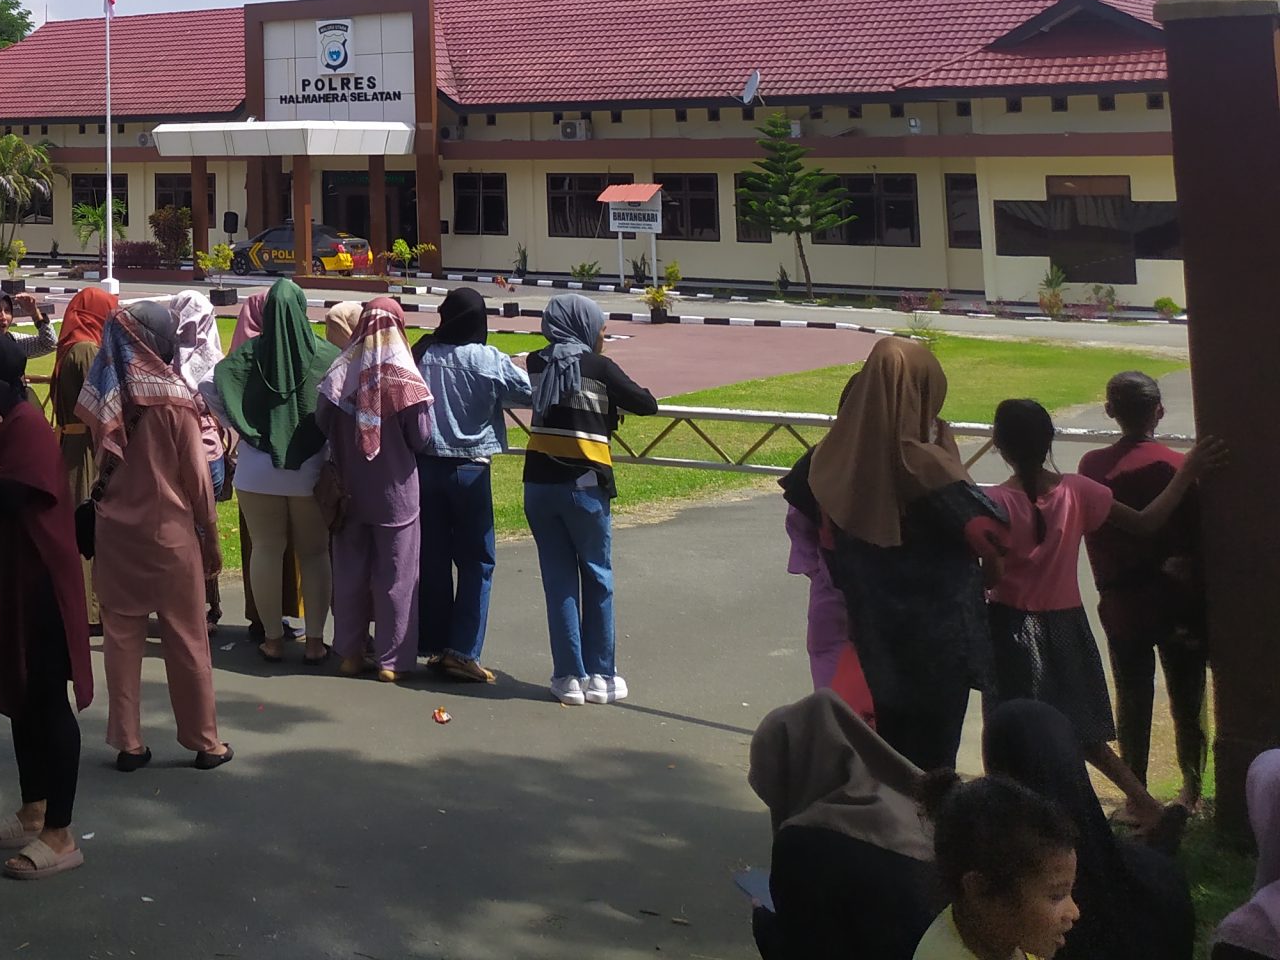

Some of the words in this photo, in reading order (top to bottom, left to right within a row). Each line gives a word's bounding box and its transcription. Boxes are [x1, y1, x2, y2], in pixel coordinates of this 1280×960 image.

[301, 76, 377, 91] POLRES
[279, 93, 348, 105] HALMAHERA
[349, 91, 402, 102] SELATAN
[612, 212, 658, 223] BHAYANGKARI
[271, 250, 295, 259] POLI
